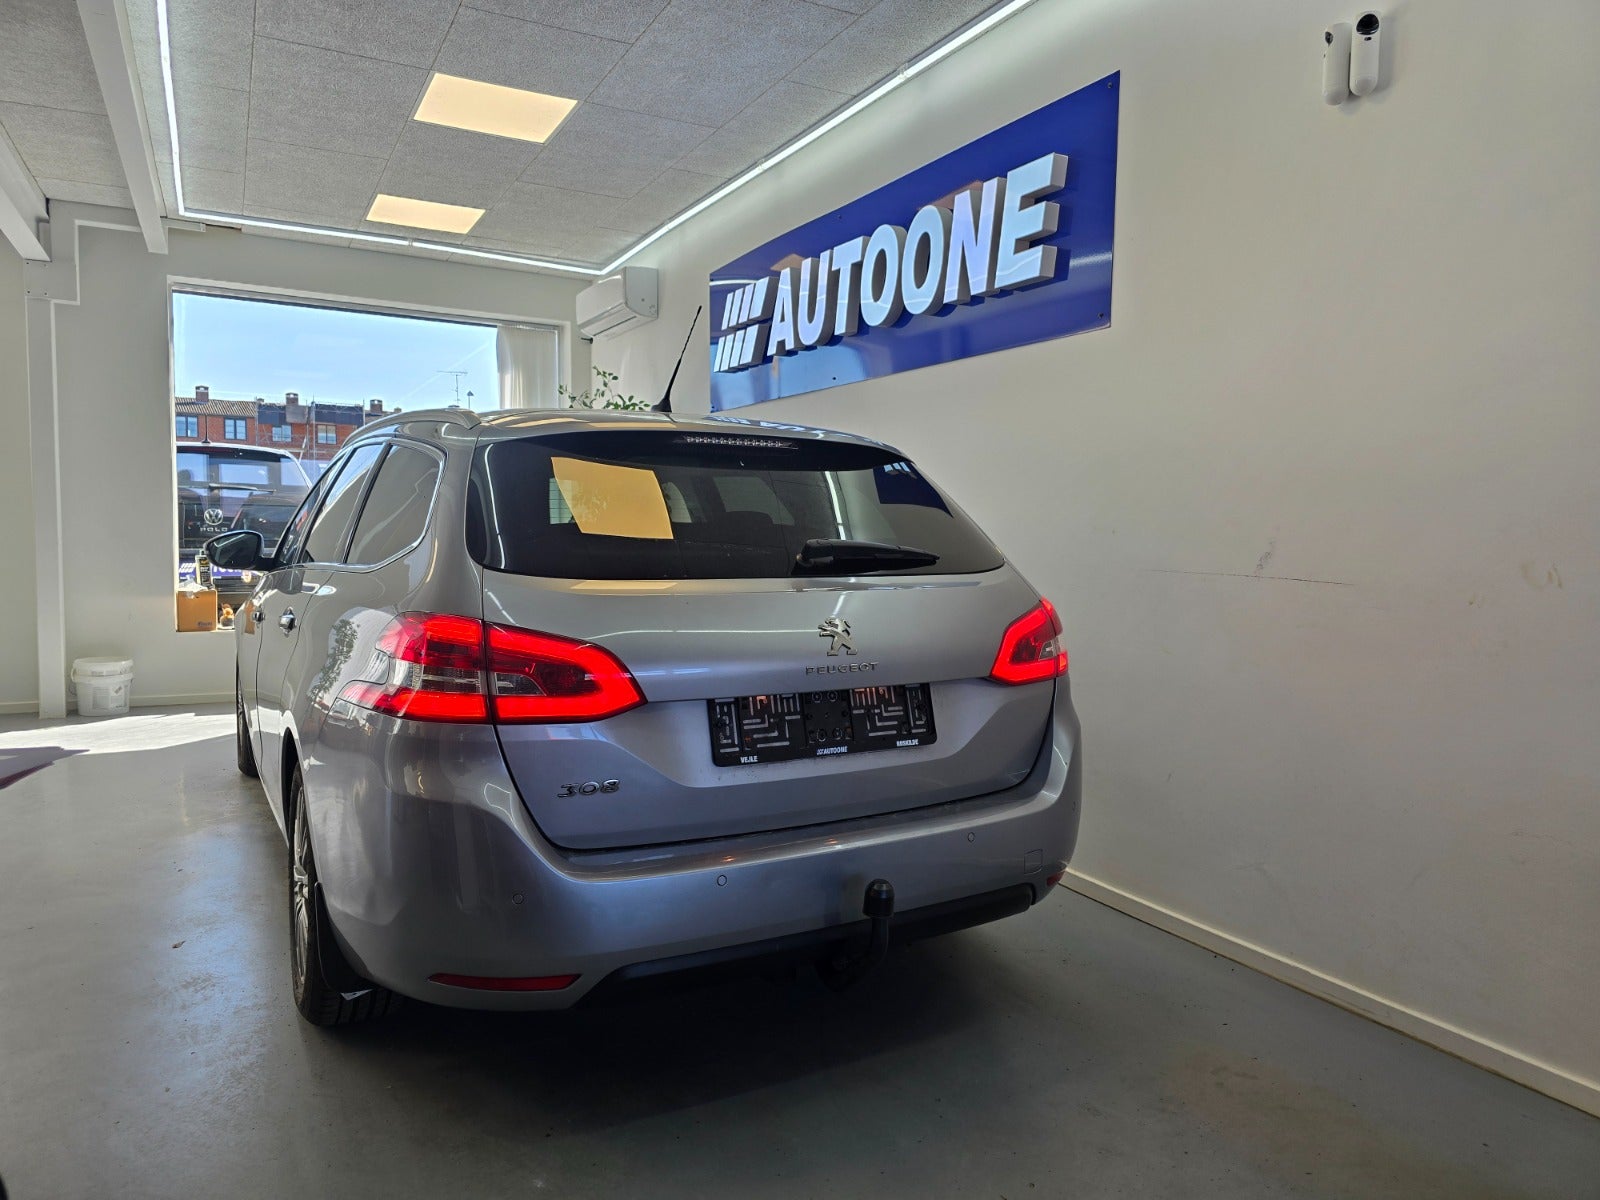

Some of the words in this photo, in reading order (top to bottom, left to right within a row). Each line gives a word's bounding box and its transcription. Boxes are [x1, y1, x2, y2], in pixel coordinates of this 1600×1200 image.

[767, 152, 1068, 356] AUTOONE
[805, 662, 879, 675] PEUGEOT
[557, 779, 619, 797] 308
